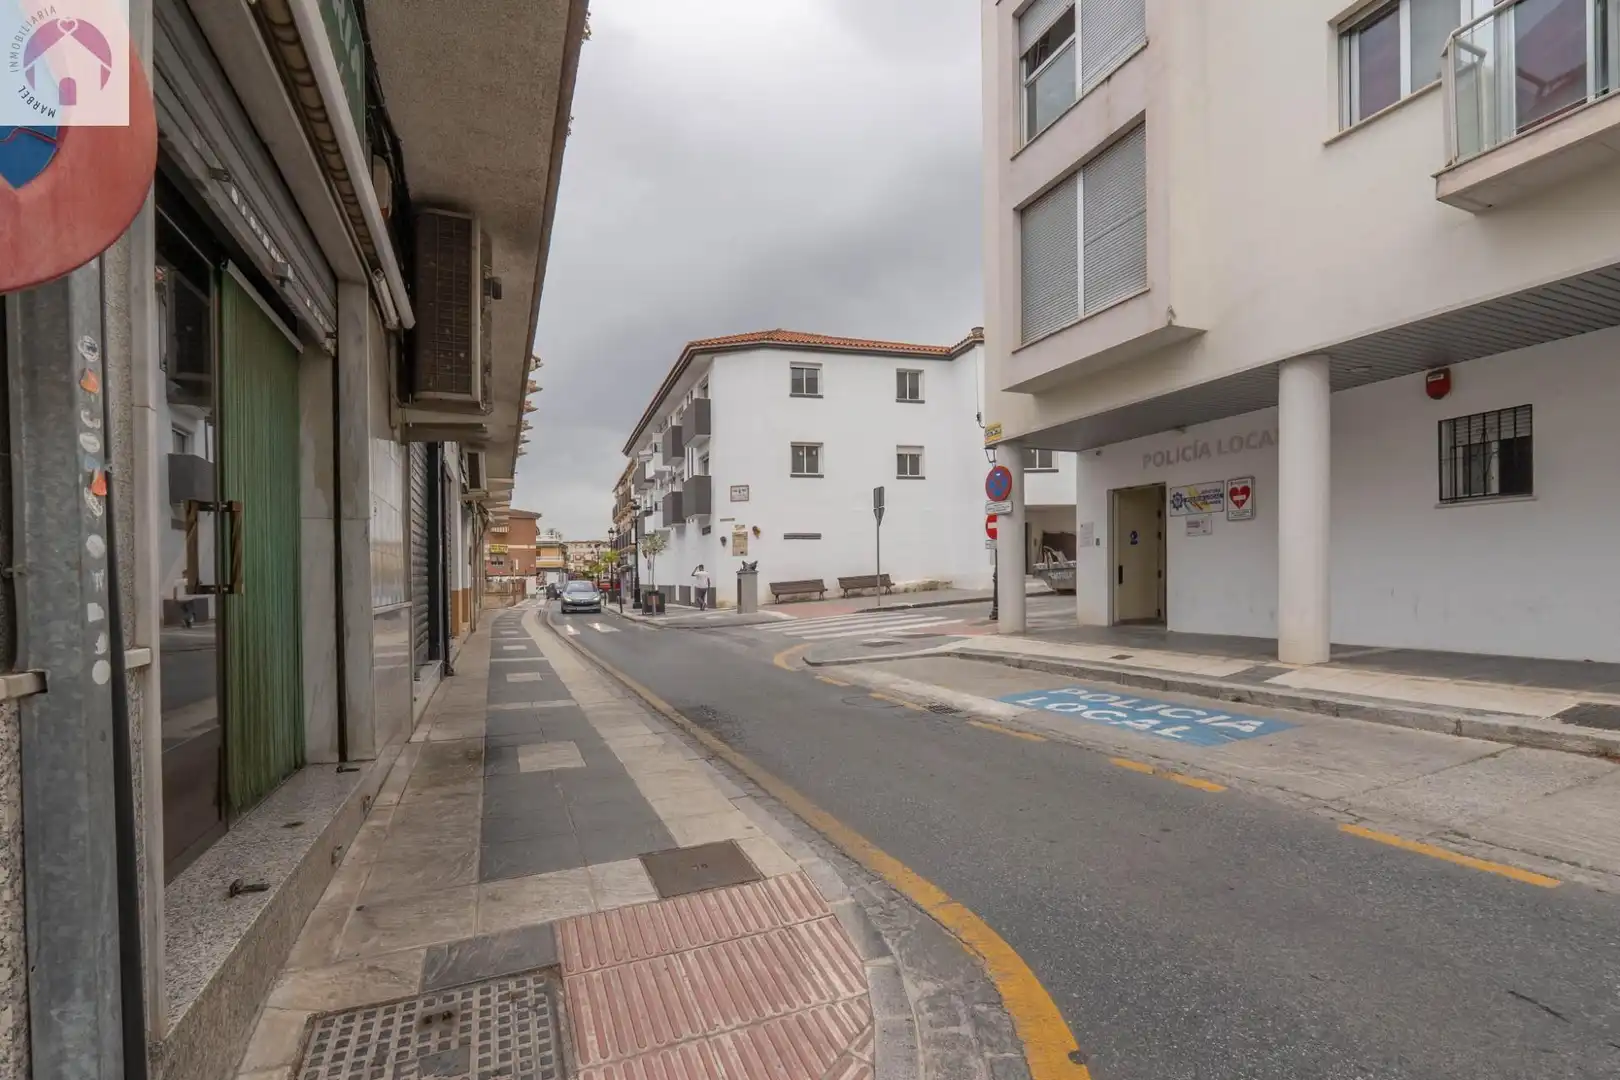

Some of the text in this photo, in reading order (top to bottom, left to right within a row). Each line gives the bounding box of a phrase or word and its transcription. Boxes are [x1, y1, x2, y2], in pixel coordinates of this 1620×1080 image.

[1141, 439, 1212, 470] POLICÍA
[1015, 696, 1192, 740] LOCAL
[1048, 687, 1265, 734] POLICIA
